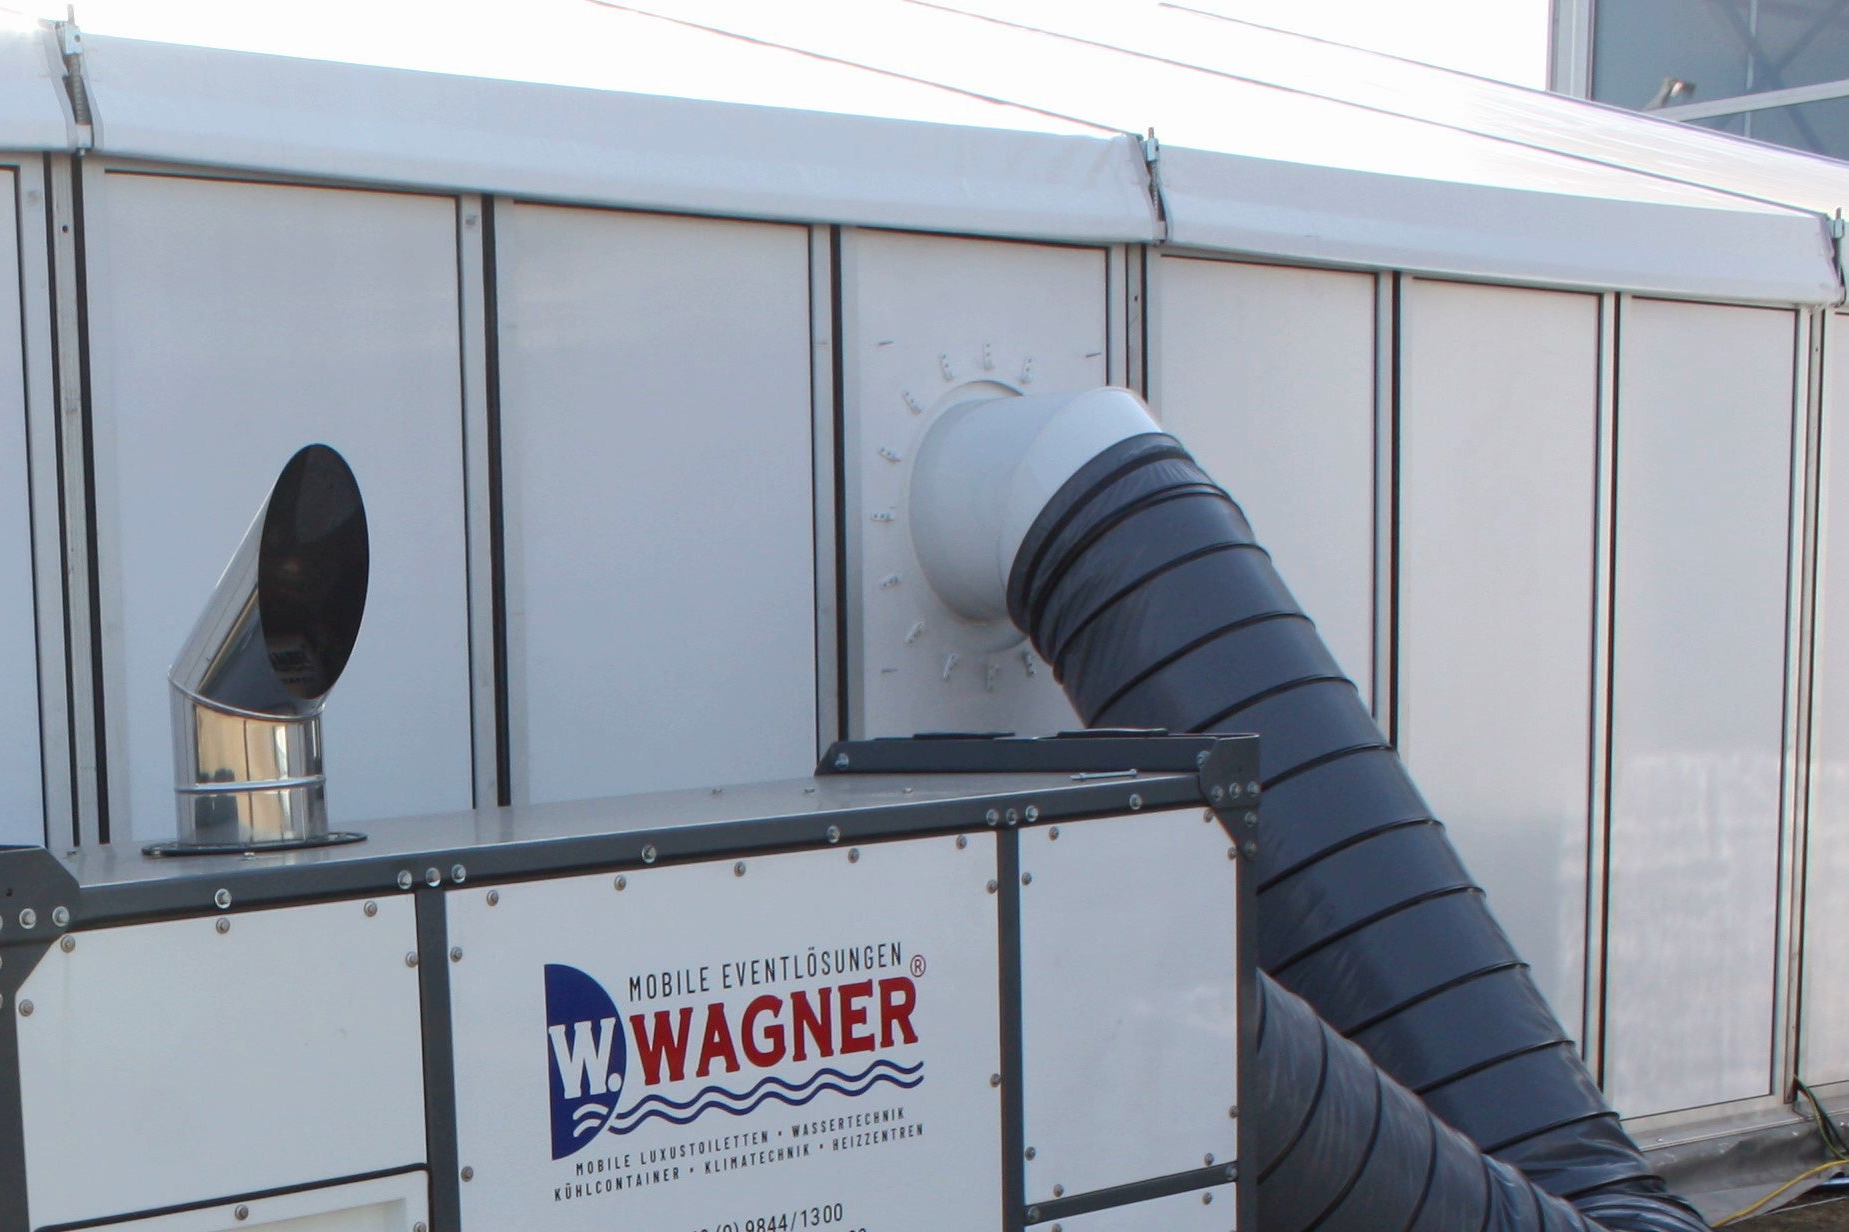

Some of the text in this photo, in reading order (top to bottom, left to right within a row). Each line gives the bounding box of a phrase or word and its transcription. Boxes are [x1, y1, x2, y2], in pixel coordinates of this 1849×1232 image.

[629, 941, 902, 1002] MOBILE EVENTLÖSUNGEN
[629, 976, 919, 1087] WAGNER
[554, 1123, 923, 1202] KÜHLCONTAINER KLIMATECHNIK HEIZZENTREN
[575, 1107, 904, 1176] MOBILE LUXUSTOILETTEN WASSERTECHNIK
